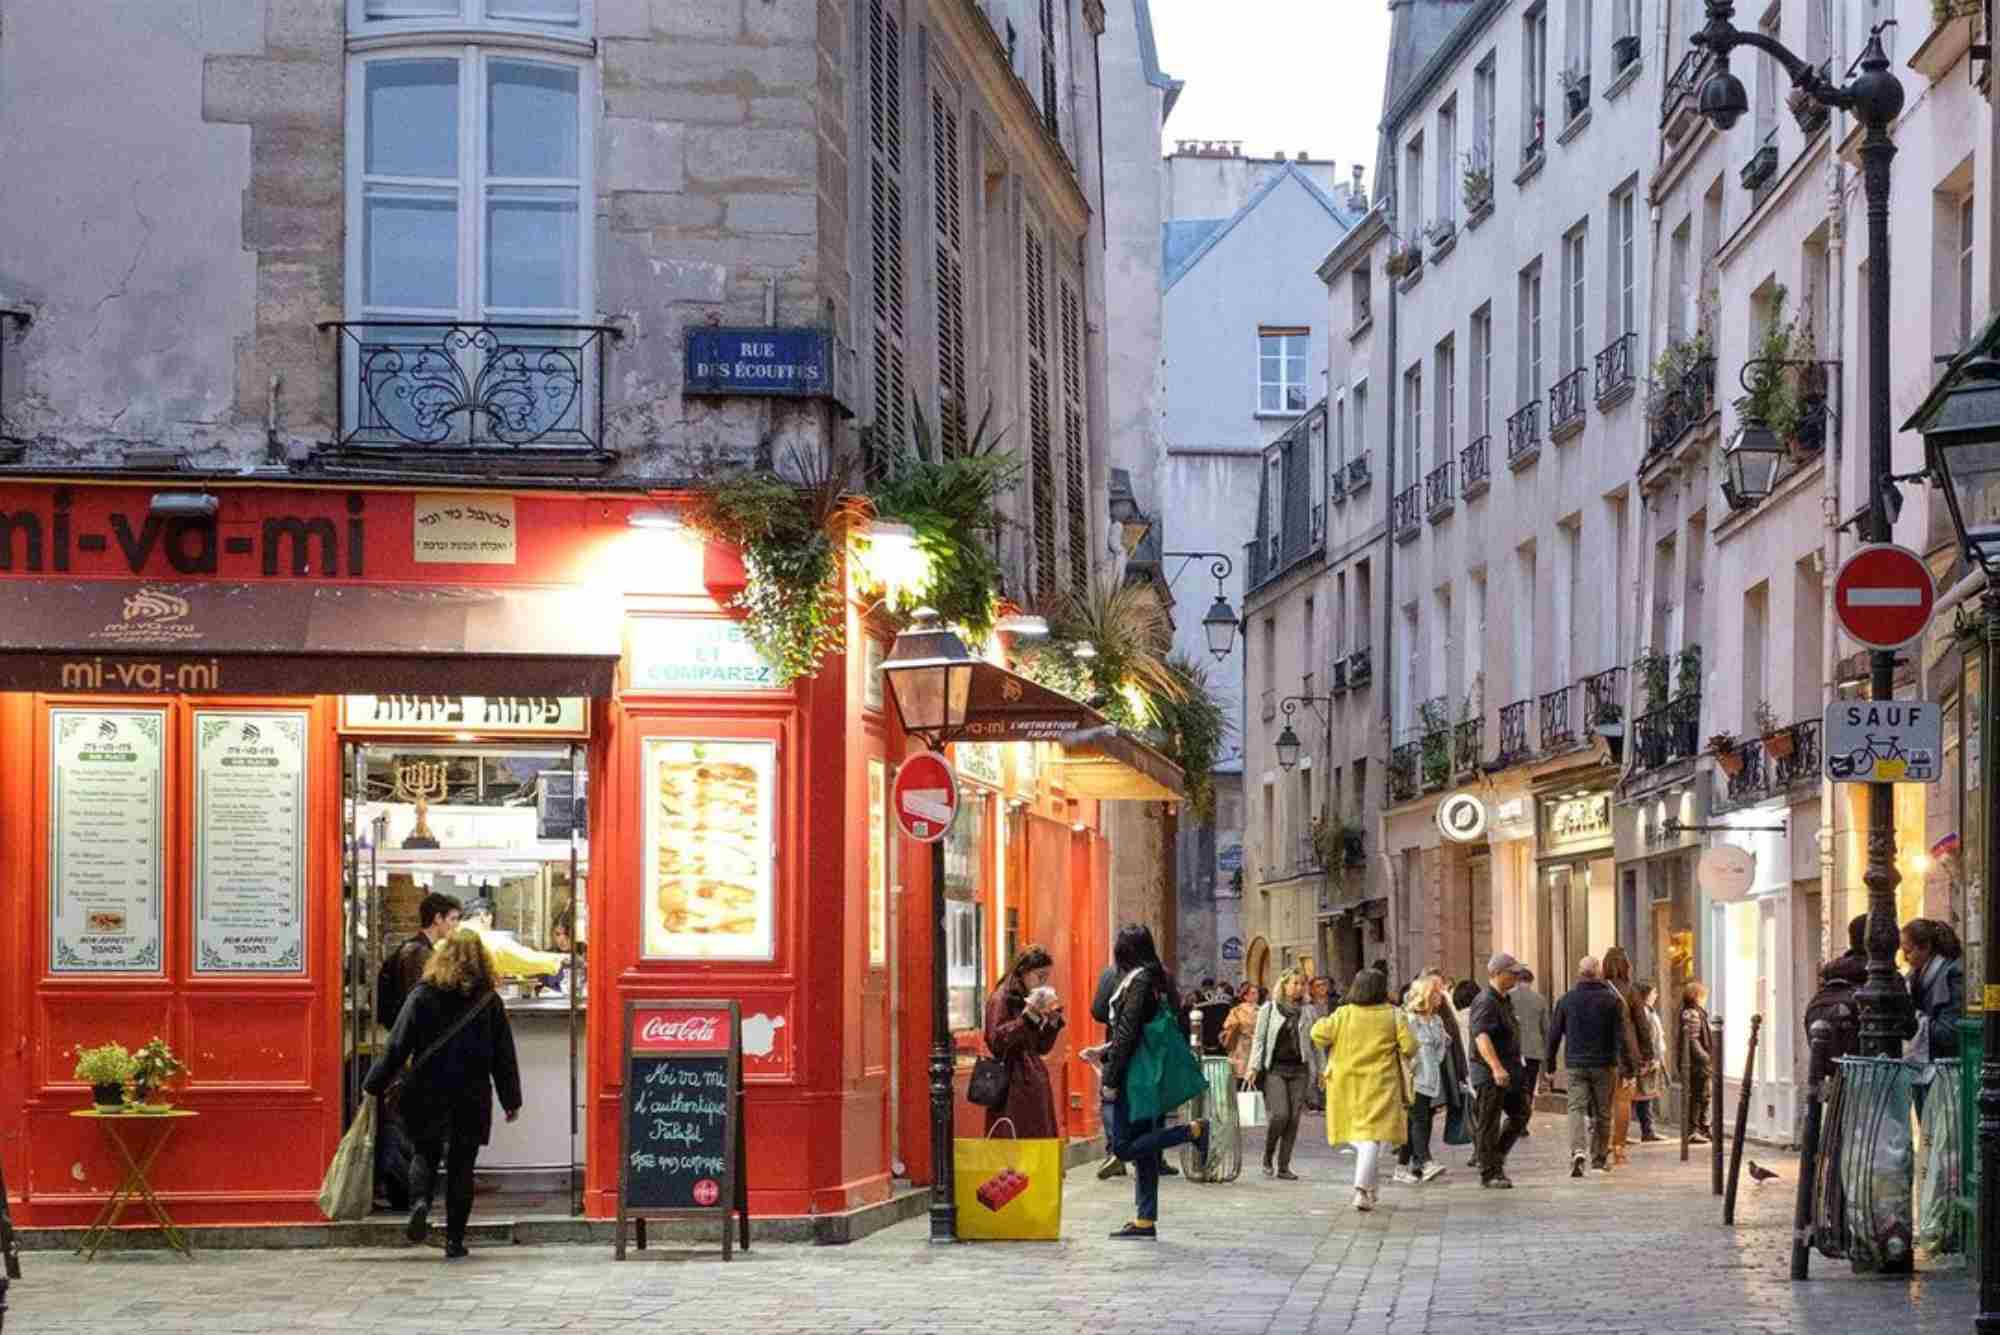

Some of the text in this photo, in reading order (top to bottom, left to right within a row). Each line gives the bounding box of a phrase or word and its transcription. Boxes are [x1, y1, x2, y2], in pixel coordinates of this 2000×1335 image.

[740, 342, 775, 358] RUE
[61, 655, 219, 689] mi-va-mi
[1847, 707, 1921, 727] SAUF
[641, 1016, 720, 1041] Coca-Cola
[679, 1072, 701, 1087] va
